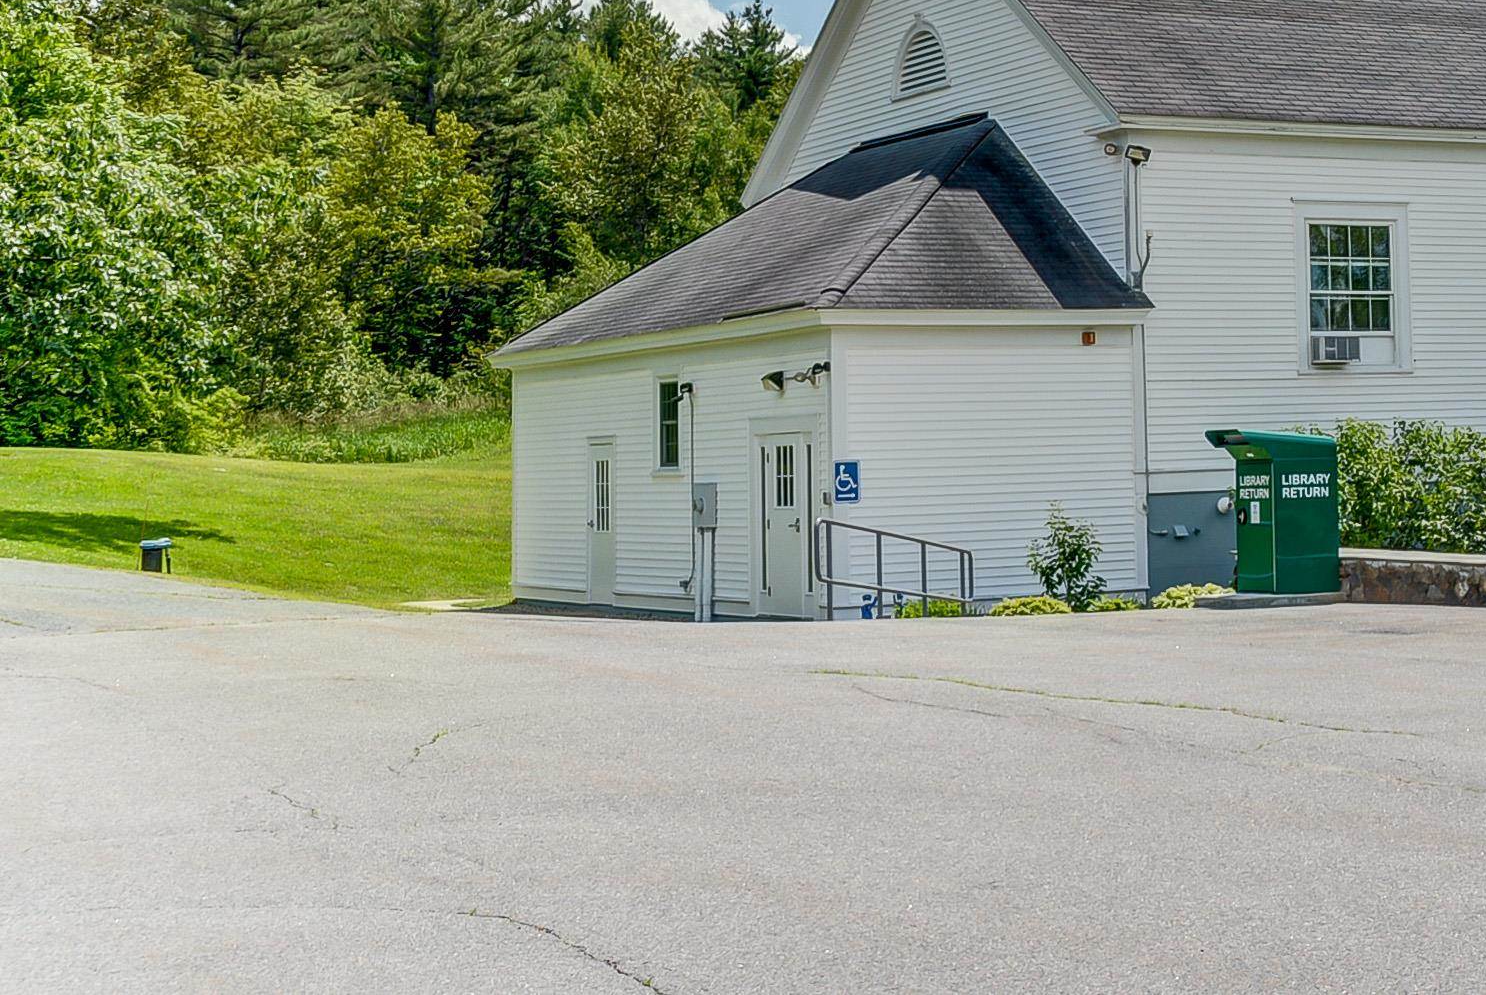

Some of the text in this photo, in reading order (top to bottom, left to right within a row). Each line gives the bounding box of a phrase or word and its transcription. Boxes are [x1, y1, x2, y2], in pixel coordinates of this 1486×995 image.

[1239, 475, 1270, 486] LIBRARY
[1281, 473, 1331, 486] LIBRARY
[1239, 488, 1270, 499] RETURN
[1281, 486, 1330, 499] RETURN
